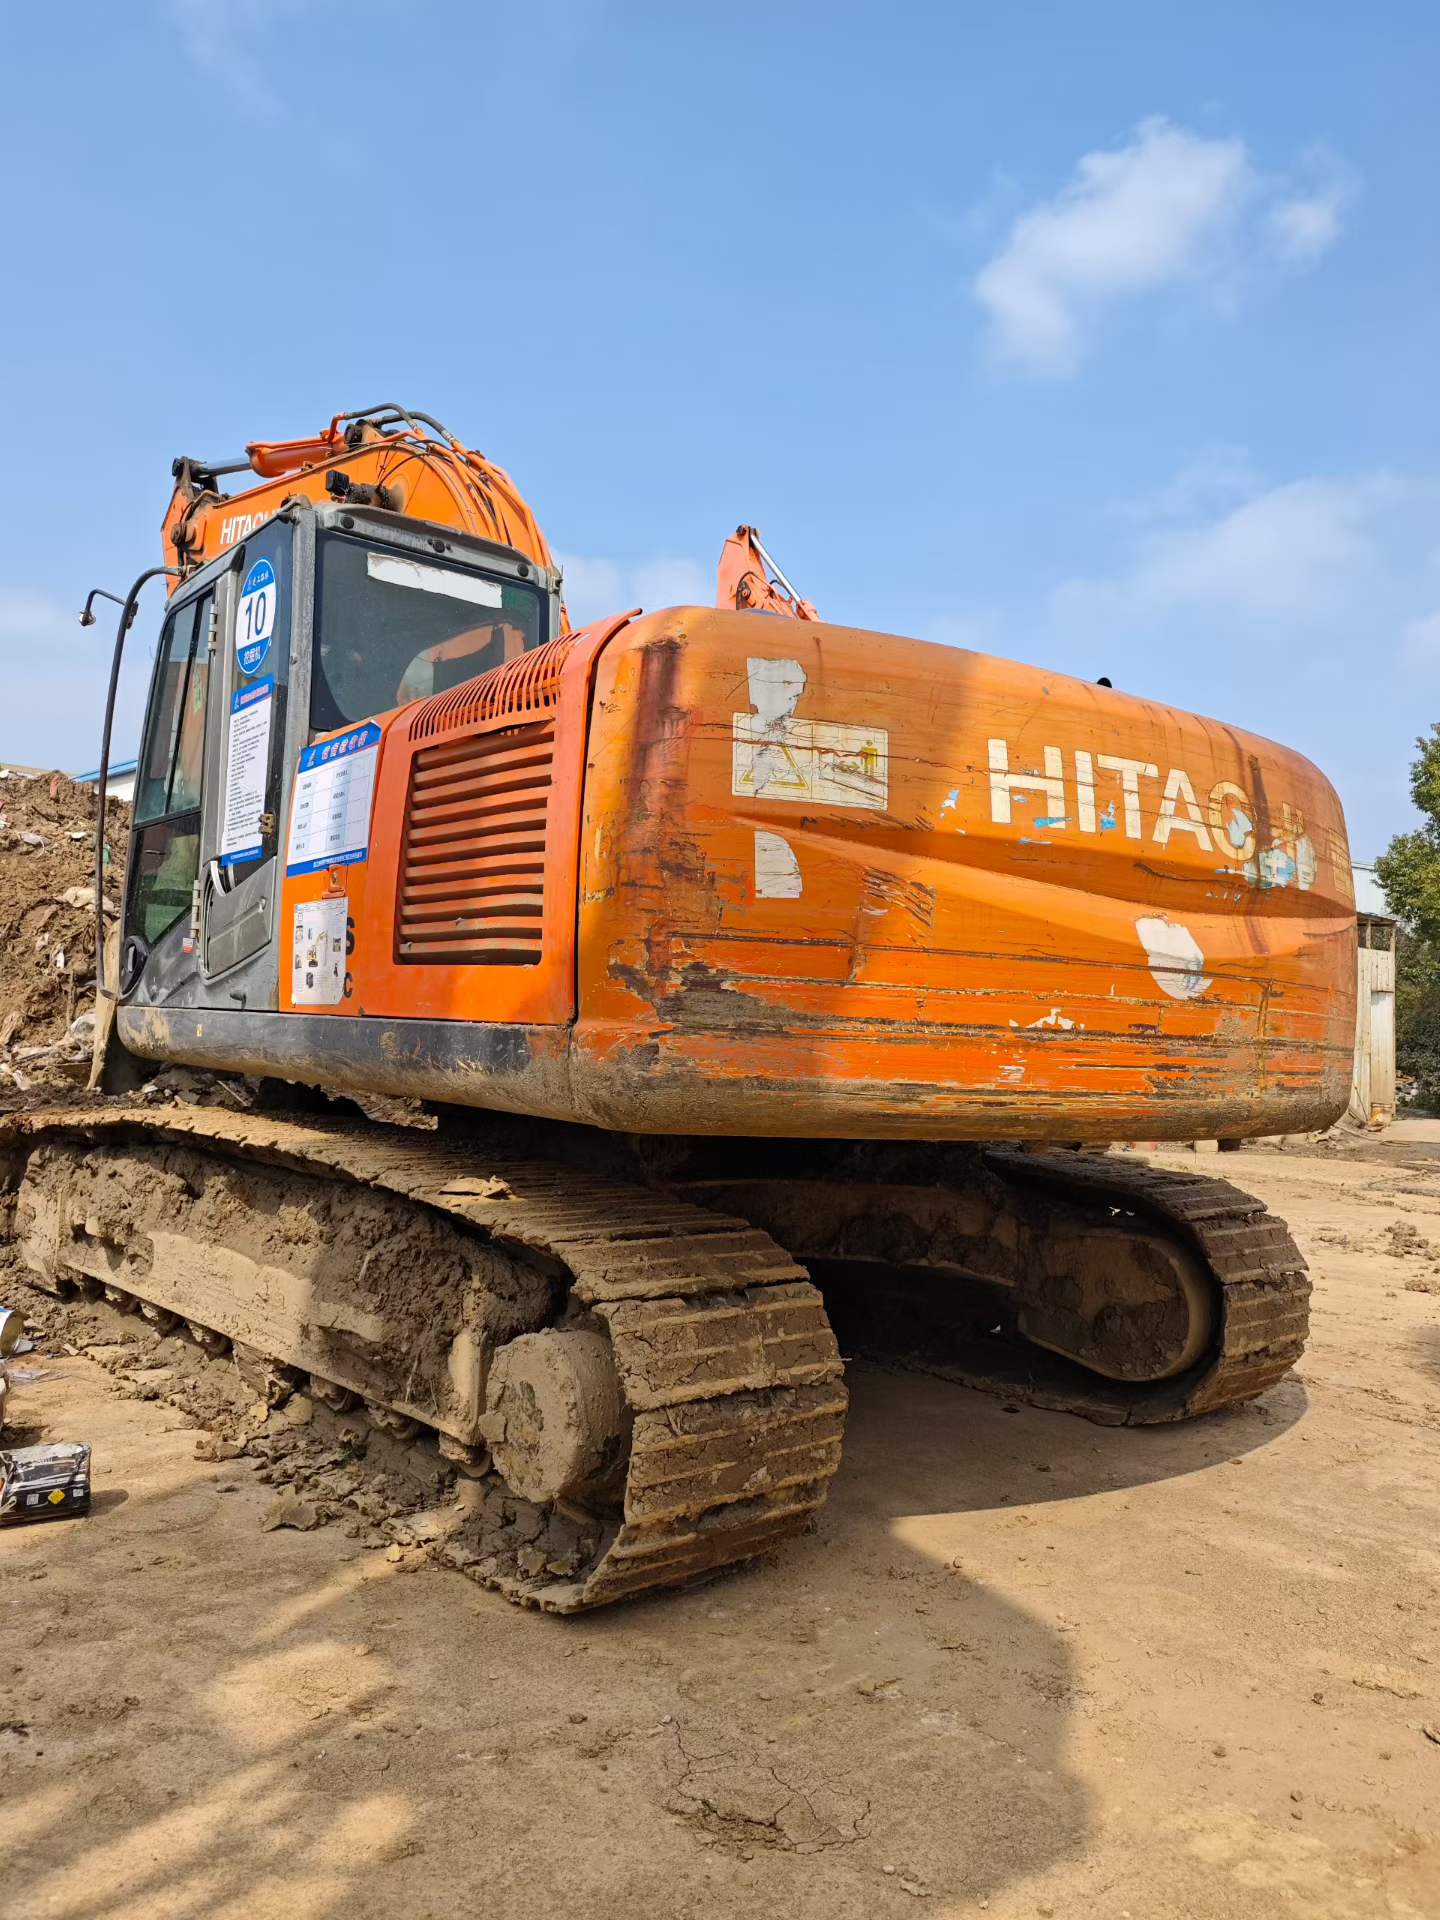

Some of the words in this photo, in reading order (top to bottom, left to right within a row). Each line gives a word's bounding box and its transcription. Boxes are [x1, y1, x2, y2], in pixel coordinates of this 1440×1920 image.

[220, 509, 281, 545] HITAC
[245, 591, 267, 640] 10
[987, 738, 1306, 878] HITAC
